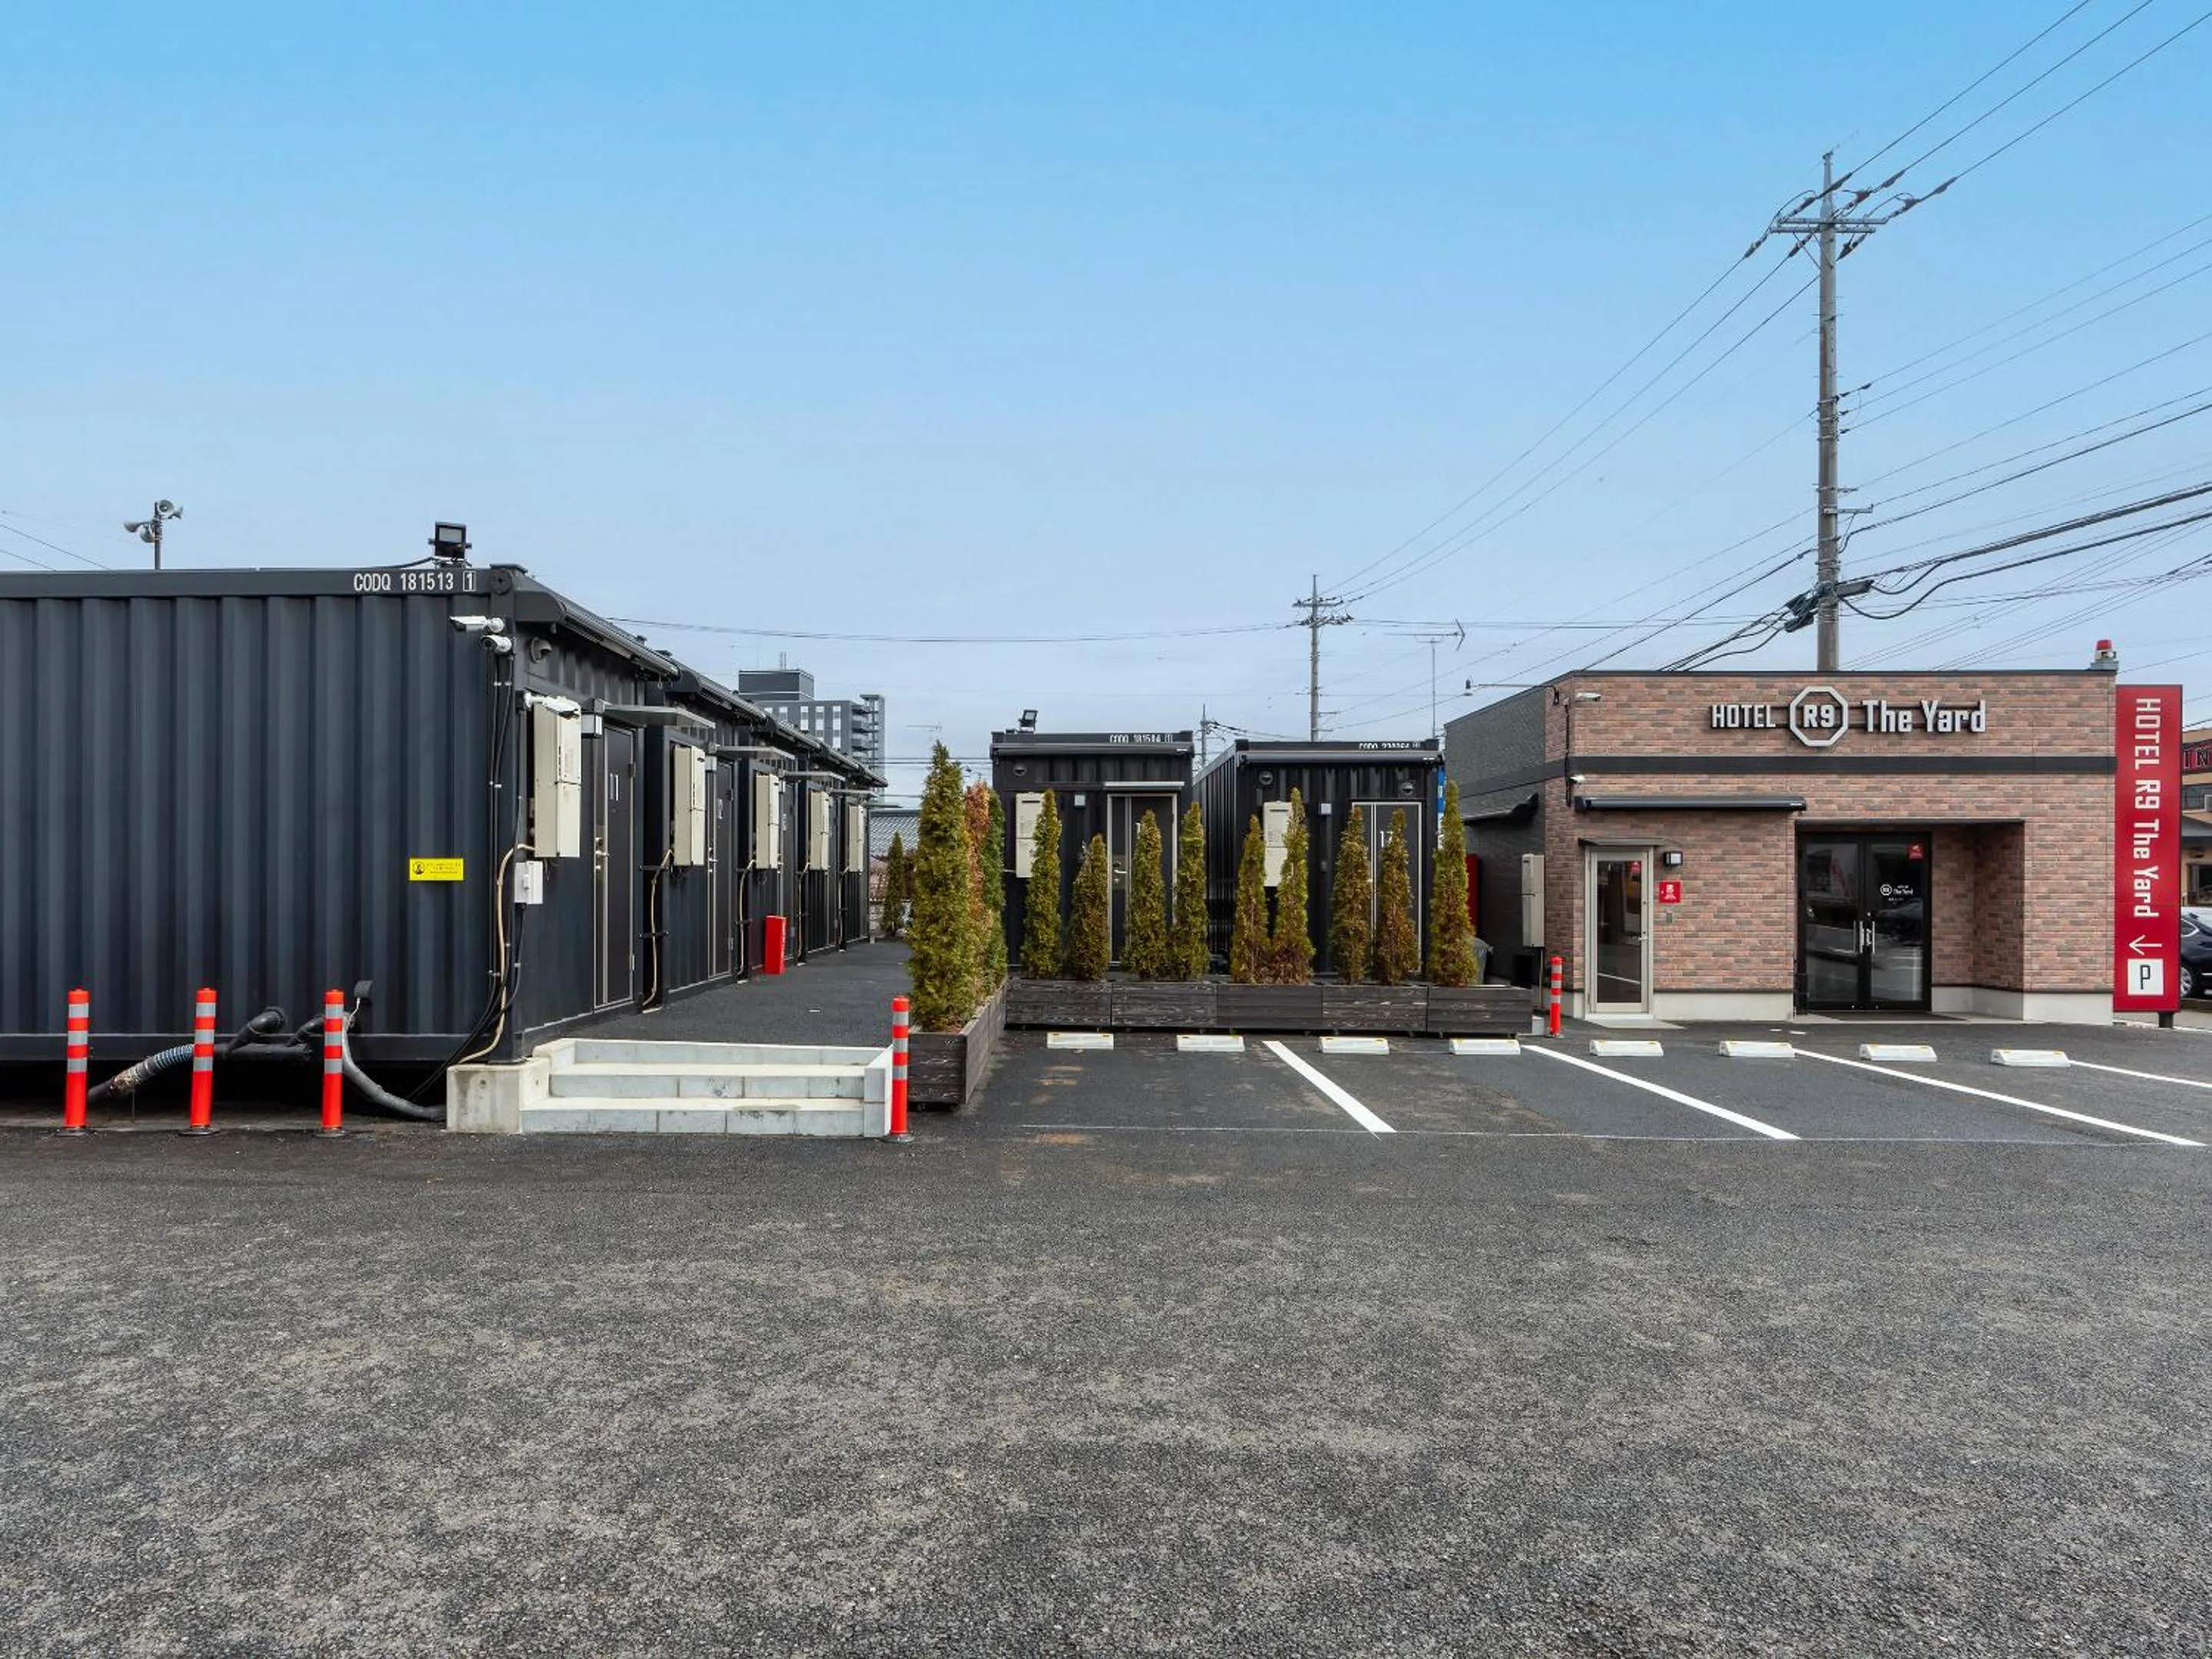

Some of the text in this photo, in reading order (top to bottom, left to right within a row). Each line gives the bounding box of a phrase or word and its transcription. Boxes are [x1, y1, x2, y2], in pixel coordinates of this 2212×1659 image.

[353, 573, 391, 591] CODQ
[401, 572, 453, 591] 181513
[1712, 700, 1985, 732] HOTEL R9 The Yard
[2133, 698, 2161, 917] HOTEL R9 The Yard
[2139, 965, 2151, 990] P
